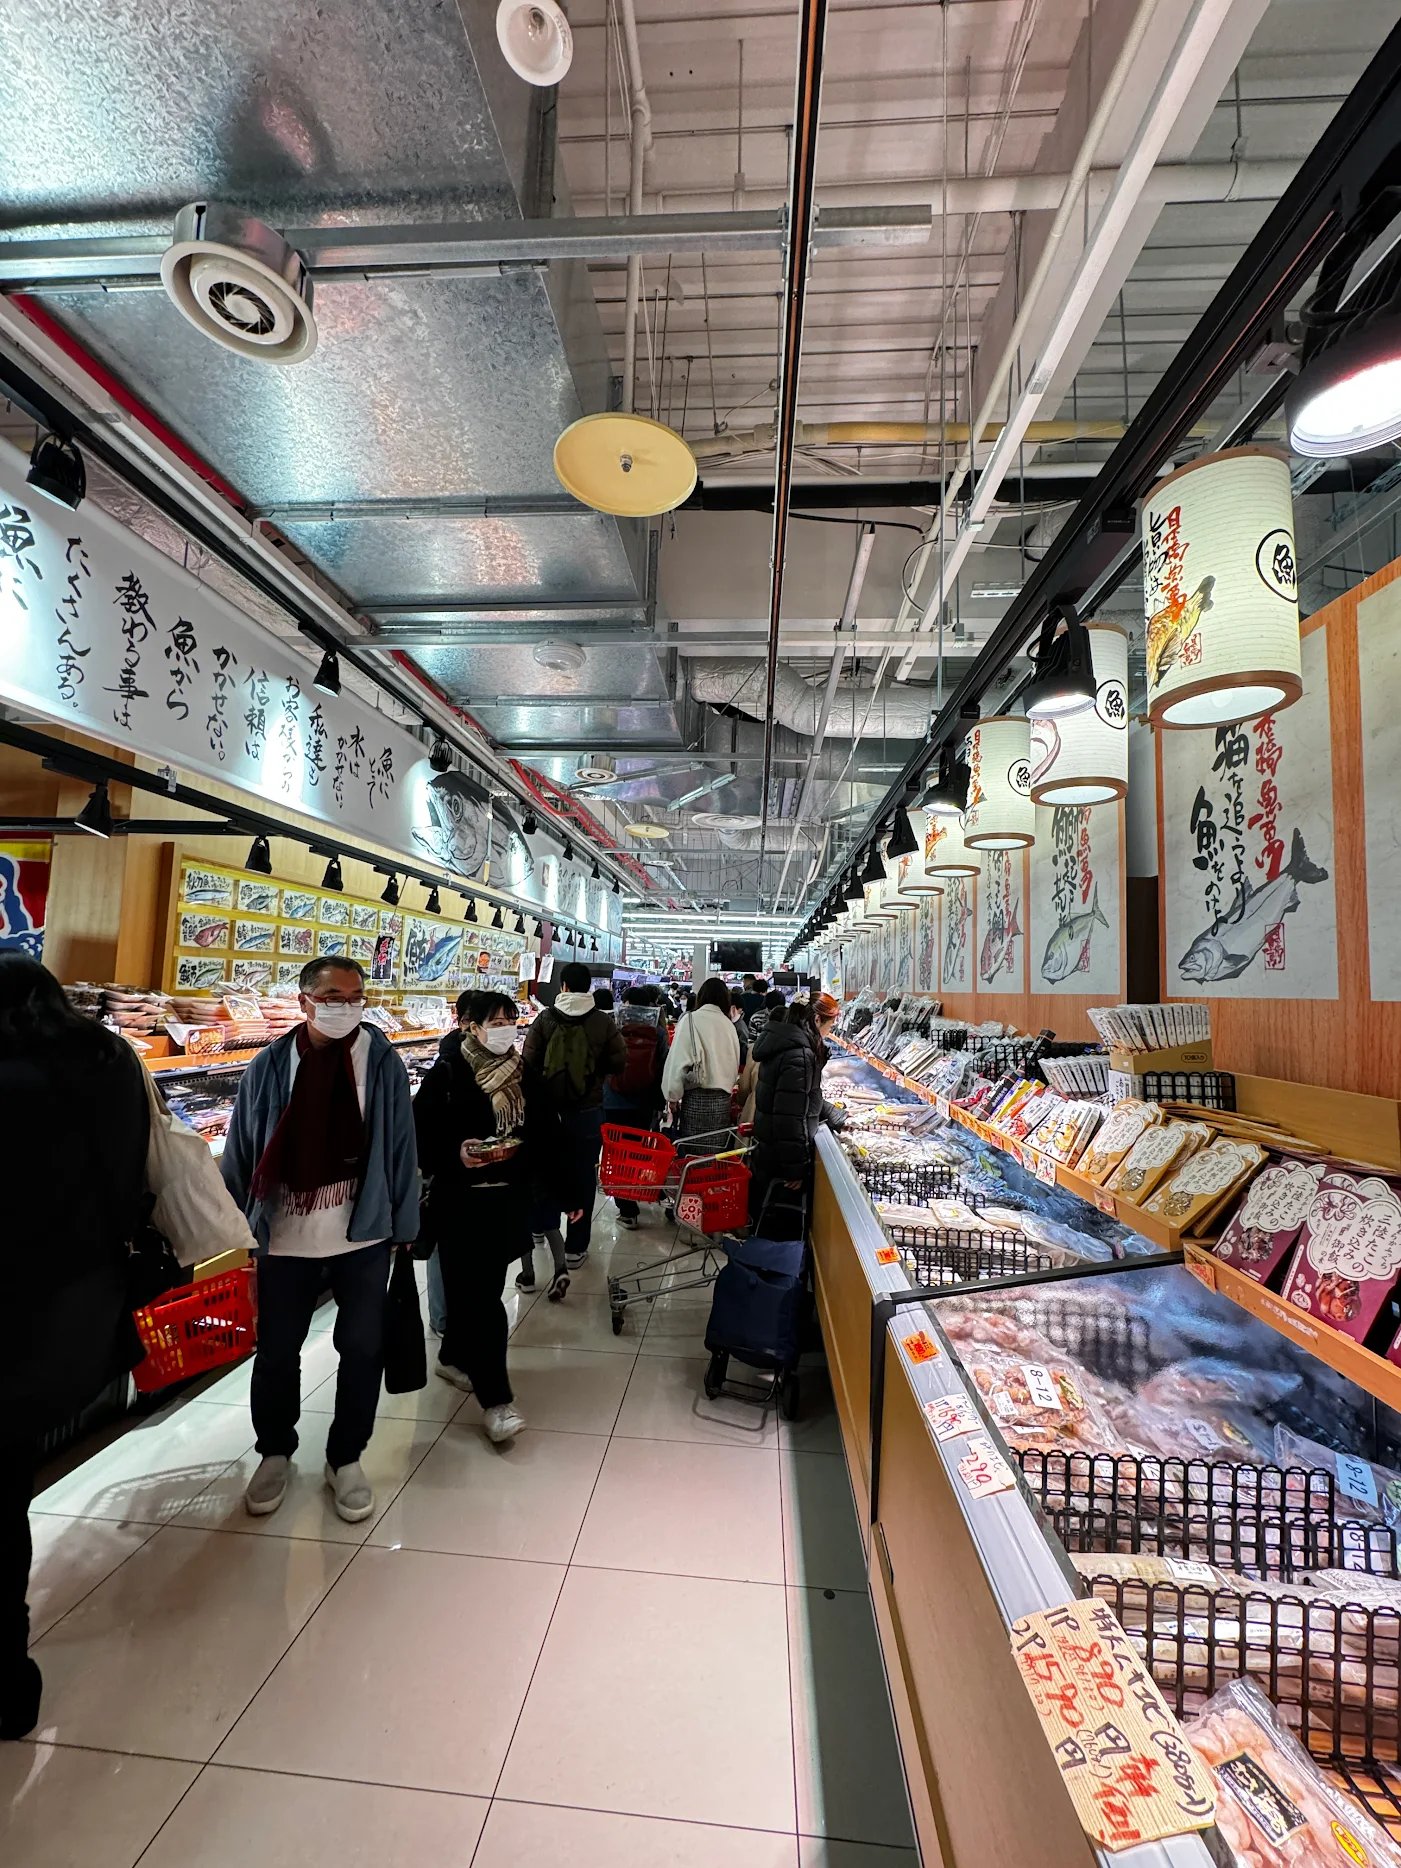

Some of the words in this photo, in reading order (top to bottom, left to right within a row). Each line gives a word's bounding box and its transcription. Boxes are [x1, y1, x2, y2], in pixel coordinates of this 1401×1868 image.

[1272, 543, 1295, 587] 魚
[55, 536, 92, 709] たくさんある。
[102, 569, 157, 731] 教わる事は
[164, 616, 200, 721] 魚から
[206, 646, 238, 761] かかせない。
[243, 666, 271, 761] 信頼は
[1105, 689, 1125, 719] 魚
[305, 703, 328, 787] 私達も
[348, 725, 366, 779] 水は
[367, 758, 378, 809] とって
[377, 747, 395, 800] 魚に
[1029, 1369, 1052, 1402] 8-12
[1345, 1460, 1369, 1497] 8-12
[1044, 1605, 1081, 1633] 1P
[1029, 1650, 1086, 1729] 1590
[1067, 1641, 1125, 1706] 890
[1055, 1737, 1088, 1770] 円
[1094, 1719, 1132, 1757] 円
